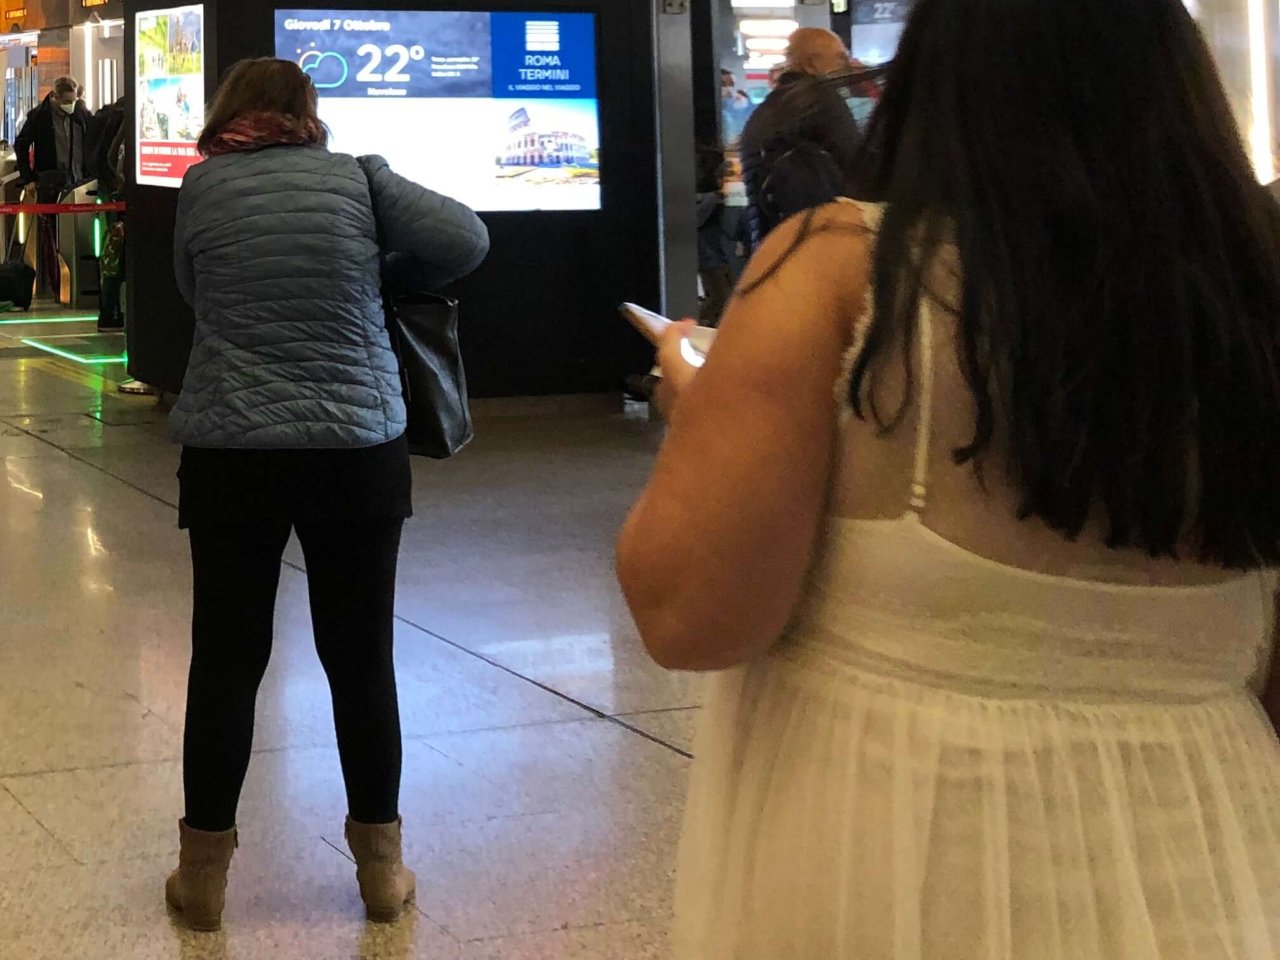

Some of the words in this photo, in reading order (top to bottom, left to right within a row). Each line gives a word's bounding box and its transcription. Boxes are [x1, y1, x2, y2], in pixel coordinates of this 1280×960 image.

[333, 20, 341, 31] 7
[343, 20, 390, 31] Ottobre
[525, 55, 561, 66] ROMA
[518, 68, 569, 80] TERMINI
